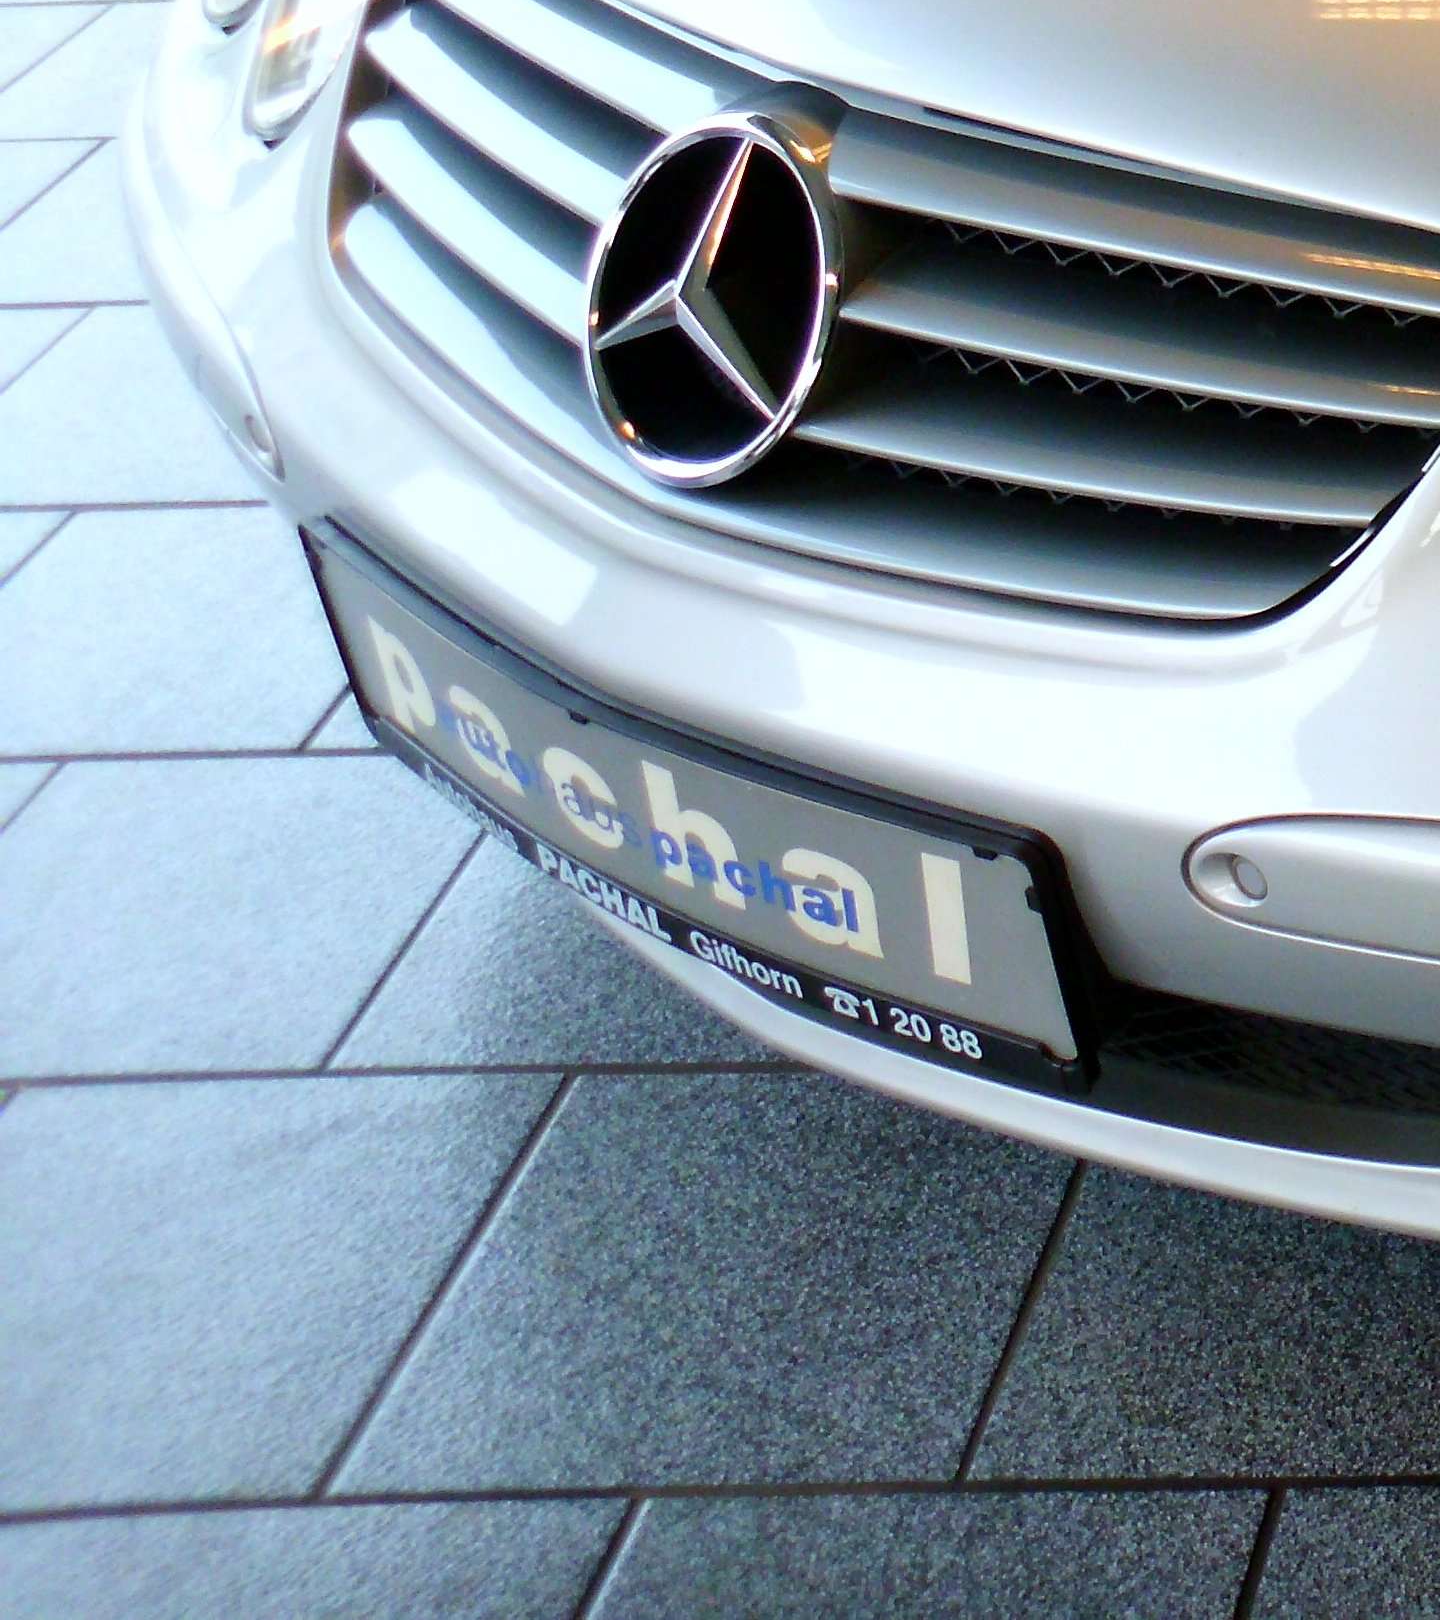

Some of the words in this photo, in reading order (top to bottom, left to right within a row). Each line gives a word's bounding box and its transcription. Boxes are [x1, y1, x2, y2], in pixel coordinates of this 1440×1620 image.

[367, 614, 972, 985] pachal
[651, 829, 859, 933] pachal
[536, 841, 672, 944] PACHAL
[690, 930, 804, 999] Gifhorn
[890, 1007, 931, 1043] 20
[939, 1022, 983, 1060] 88
